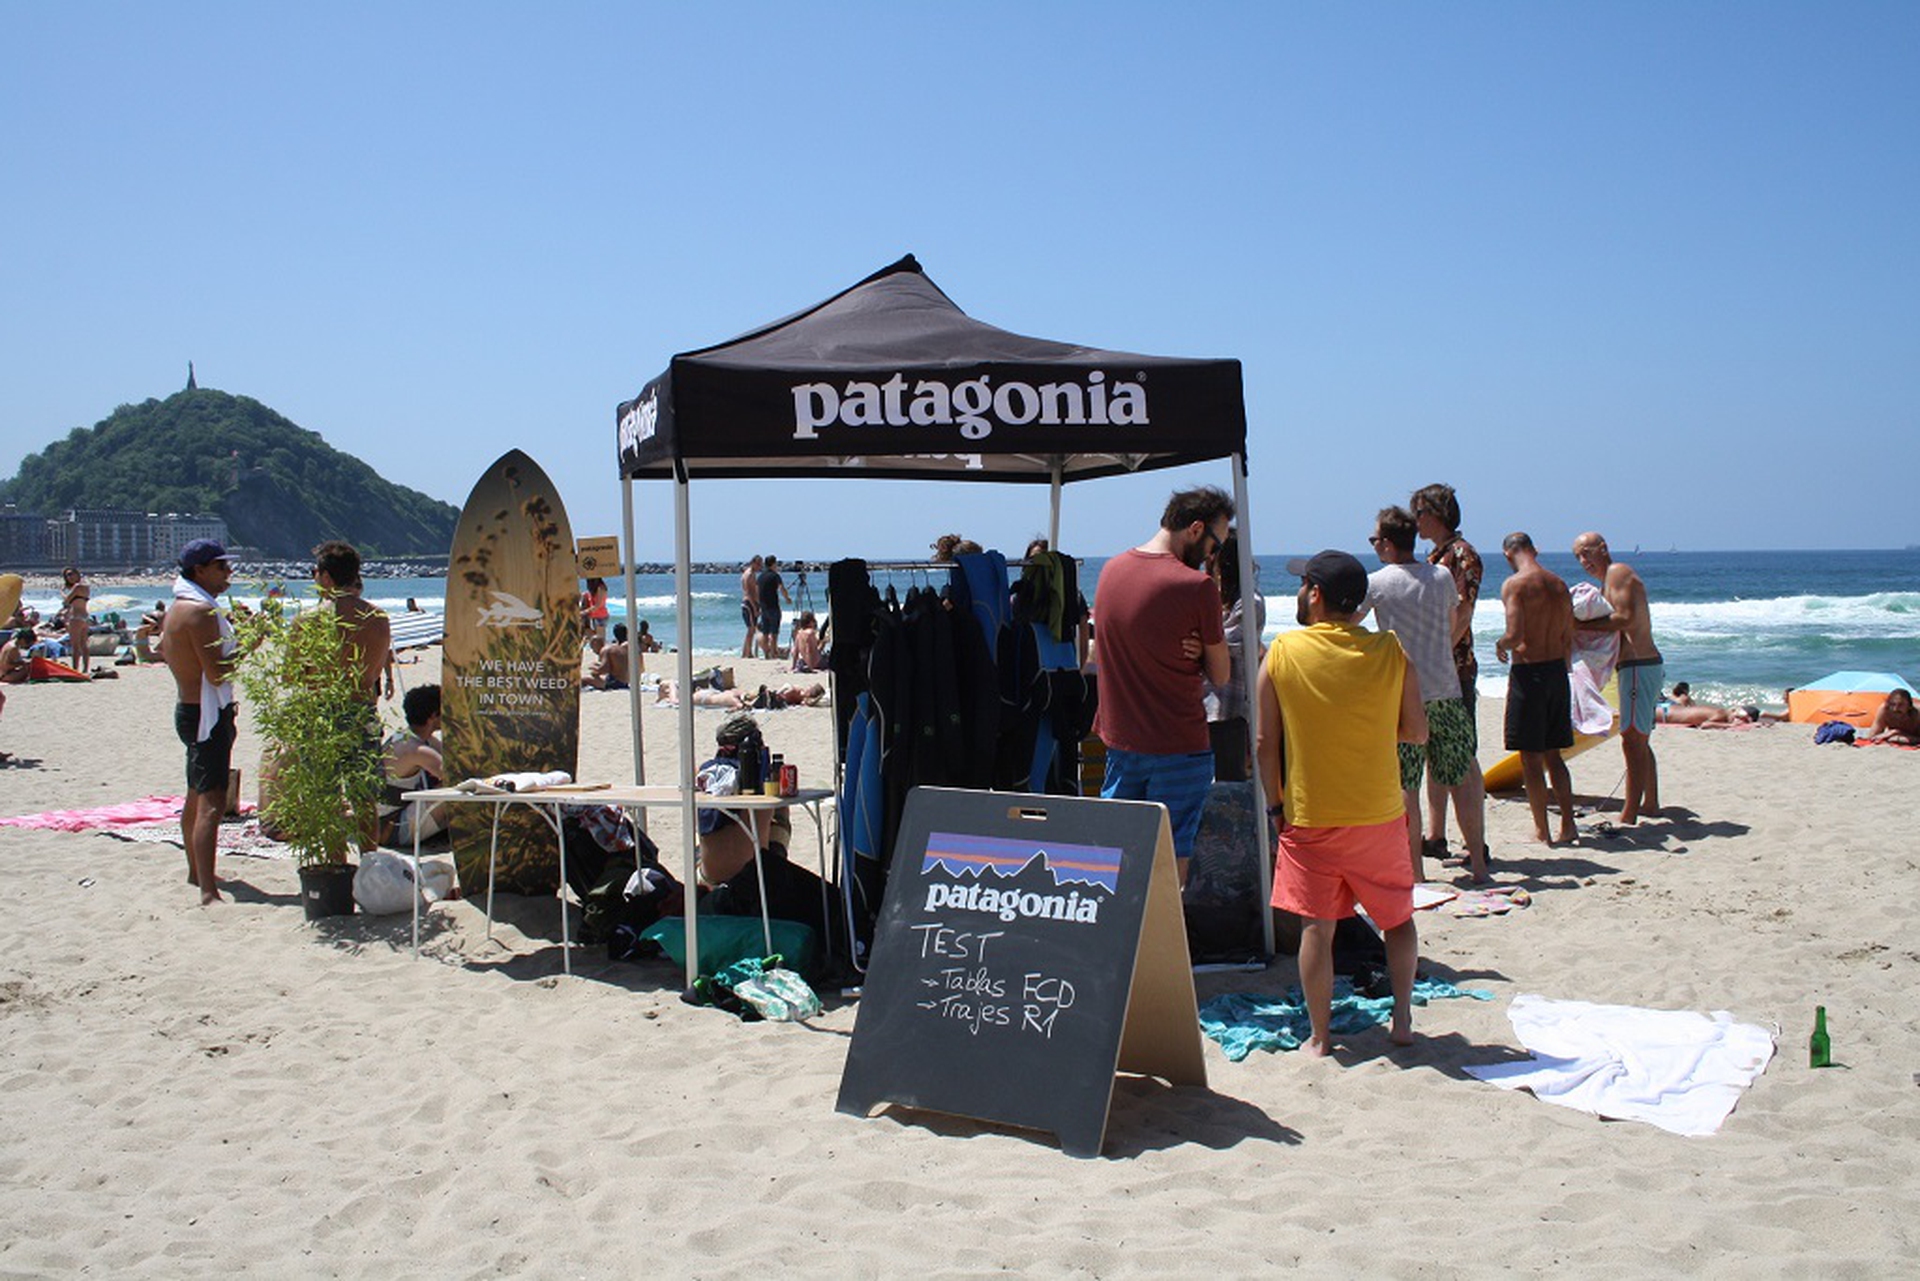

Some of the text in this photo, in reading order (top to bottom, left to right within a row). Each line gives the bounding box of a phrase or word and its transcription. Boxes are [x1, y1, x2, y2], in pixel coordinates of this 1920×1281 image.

[792, 371, 1149, 440] patagonia
[456, 676, 568, 689] THE BEST WEED
[479, 659, 545, 672] WE HAVE
[479, 693, 544, 705] IN TOWN
[923, 883, 1100, 923] patagonia
[911, 923, 1004, 962] TEST
[941, 967, 1006, 998] Tablas
[940, 995, 1010, 1035] Trajes
